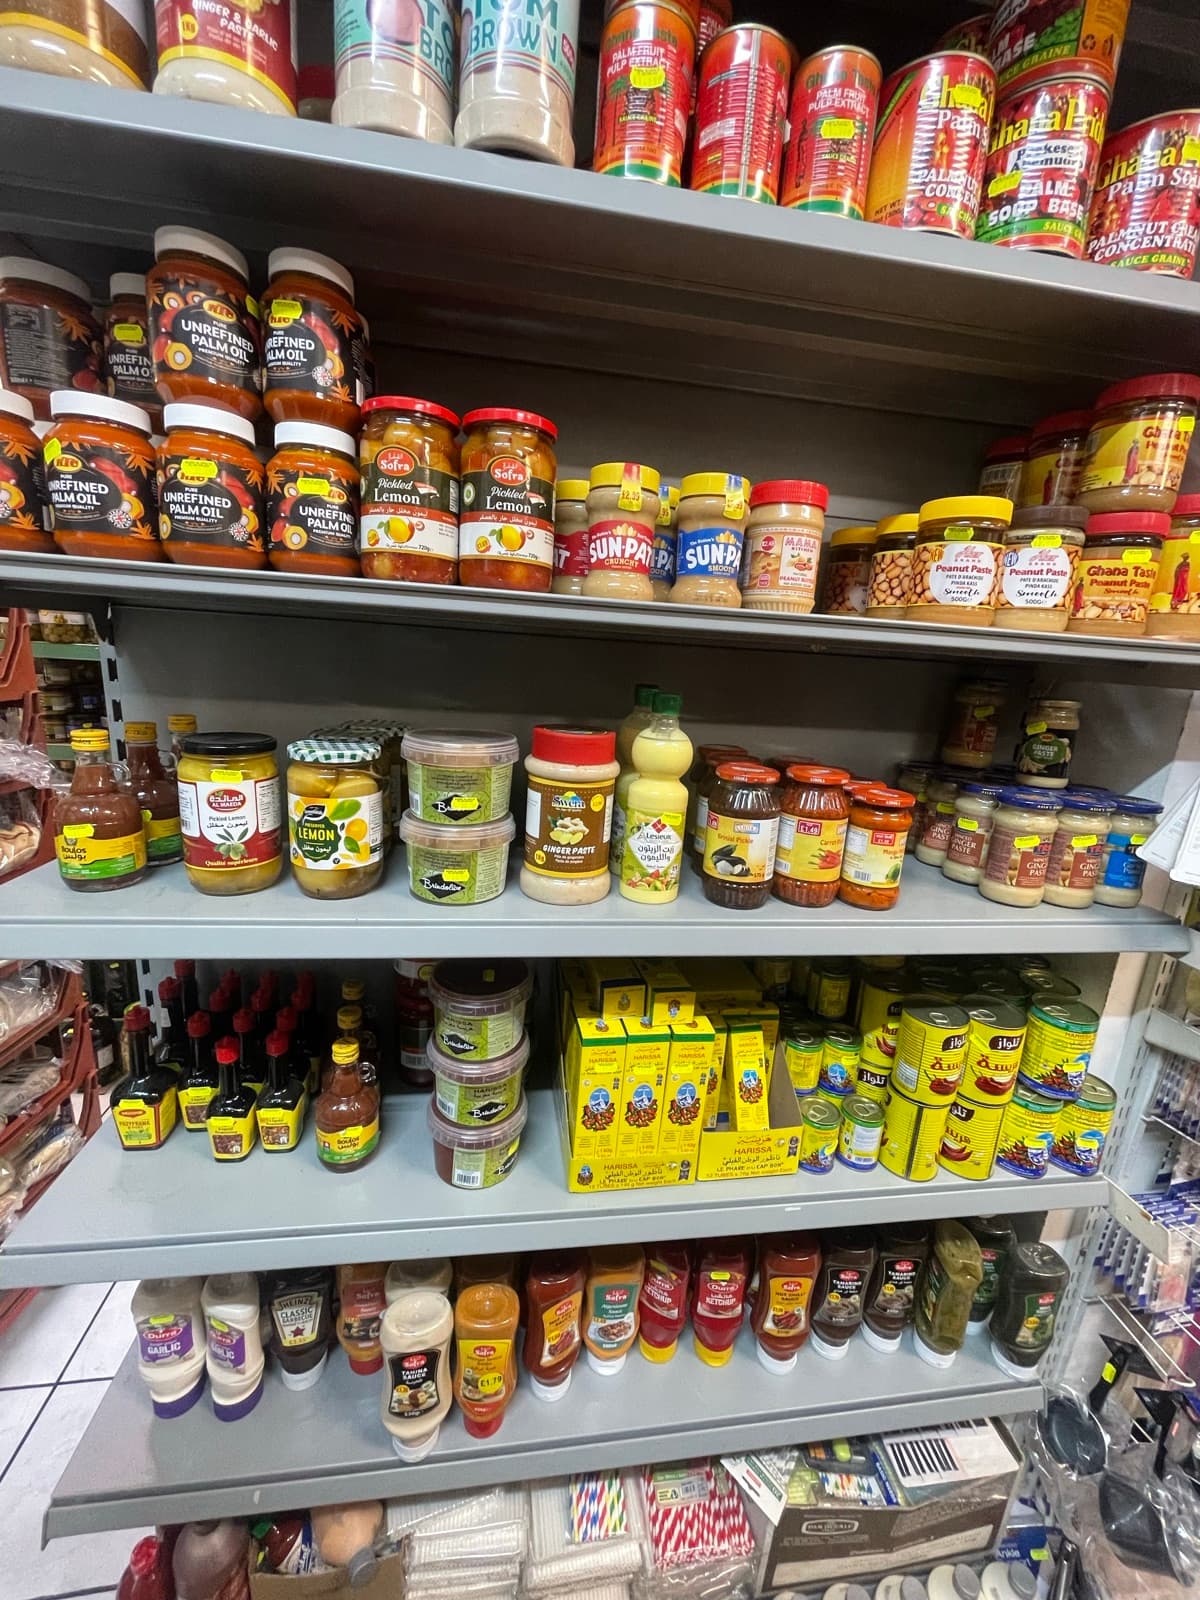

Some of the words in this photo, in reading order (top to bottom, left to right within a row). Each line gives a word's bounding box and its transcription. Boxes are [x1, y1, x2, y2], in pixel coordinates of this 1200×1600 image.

[192, 0, 230, 18] GINGER
[233, 12, 241, 23] &
[245, 17, 279, 51] GARLIC
[220, 18, 254, 39] PASTE
[470, 19, 557, 64] BROWN
[1023, 45, 1071, 67] GRAINE
[607, 58, 627, 77] PULP
[629, 56, 671, 70] EXTRACT
[816, 88, 842, 100] PALM
[834, 98, 870, 115] EXTRACT
[1095, 146, 1178, 192] Ghana
[1107, 172, 1165, 201] Palm
[988, 199, 1039, 227] SOUP
[1048, 198, 1085, 222] BASE
[1088, 221, 1169, 253] PALMNUT
[1110, 255, 1150, 268] SAUCE
[1152, 254, 1187, 267] GRAINE
[181, 319, 254, 352] UNREFINED
[191, 334, 229, 355] PALM
[230, 345, 249, 363] OIL
[266, 337, 315, 350] REFINED
[108, 354, 151, 366] UNREFIN
[198, 348, 224, 359] PREMIUM
[224, 352, 246, 366] QUALITY
[286, 350, 308, 362] OIL
[113, 365, 139, 376] PALM
[380, 460, 410, 473] Sofra
[494, 470, 524, 483] Sofra
[377, 477, 414, 490] Pickled
[52, 491, 75, 503] PALM
[76, 493, 101, 506] OIL
[374, 488, 420, 505] Lemon
[491, 486, 528, 500] Pickled
[164, 492, 232, 509] UNREFINED
[486, 495, 532, 514] Lemon
[169, 503, 200, 516] PALM
[201, 506, 224, 519] OIL
[307, 517, 339, 531] PALM
[340, 522, 353, 535] OIL
[785, 537, 817, 549] MAMA
[605, 558, 639, 567] CRUNCHY
[708, 565, 735, 574] SMOOTH
[935, 564, 969, 573] Peanut
[971, 565, 992, 575] Paste
[1009, 568, 1043, 576] Peanut
[1045, 568, 1067, 577] Paste
[1086, 565, 1129, 577] Ghana
[1090, 579, 1126, 588] Peanut
[1129, 580, 1150, 588] Paste
[1032, 743, 1058, 752] GINGER
[227, 821, 248, 829] ليمون
[930, 825, 949, 835] GING
[298, 827, 335, 841] LEMON
[646, 832, 672, 840] Lesieur
[543, 844, 571, 855] GINGER
[572, 846, 596, 855] PASTE
[951, 844, 971, 855] PASTE
[1080, 862, 1100, 870] GING
[997, 1037, 1020, 1051] تلواز
[861, 1071, 886, 1086] تلواز
[734, 1146, 772, 1155] HARISSA
[603, 1163, 638, 1171] HARISSA
[283, 1296, 312, 1308] HEINZ
[706, 1297, 737, 1306] KETCHUP
[280, 1306, 313, 1319] CLASSIC
[148, 1331, 178, 1340] Durra
[147, 1342, 181, 1354] GARLIC
[480, 1375, 502, 1387] £1.79
